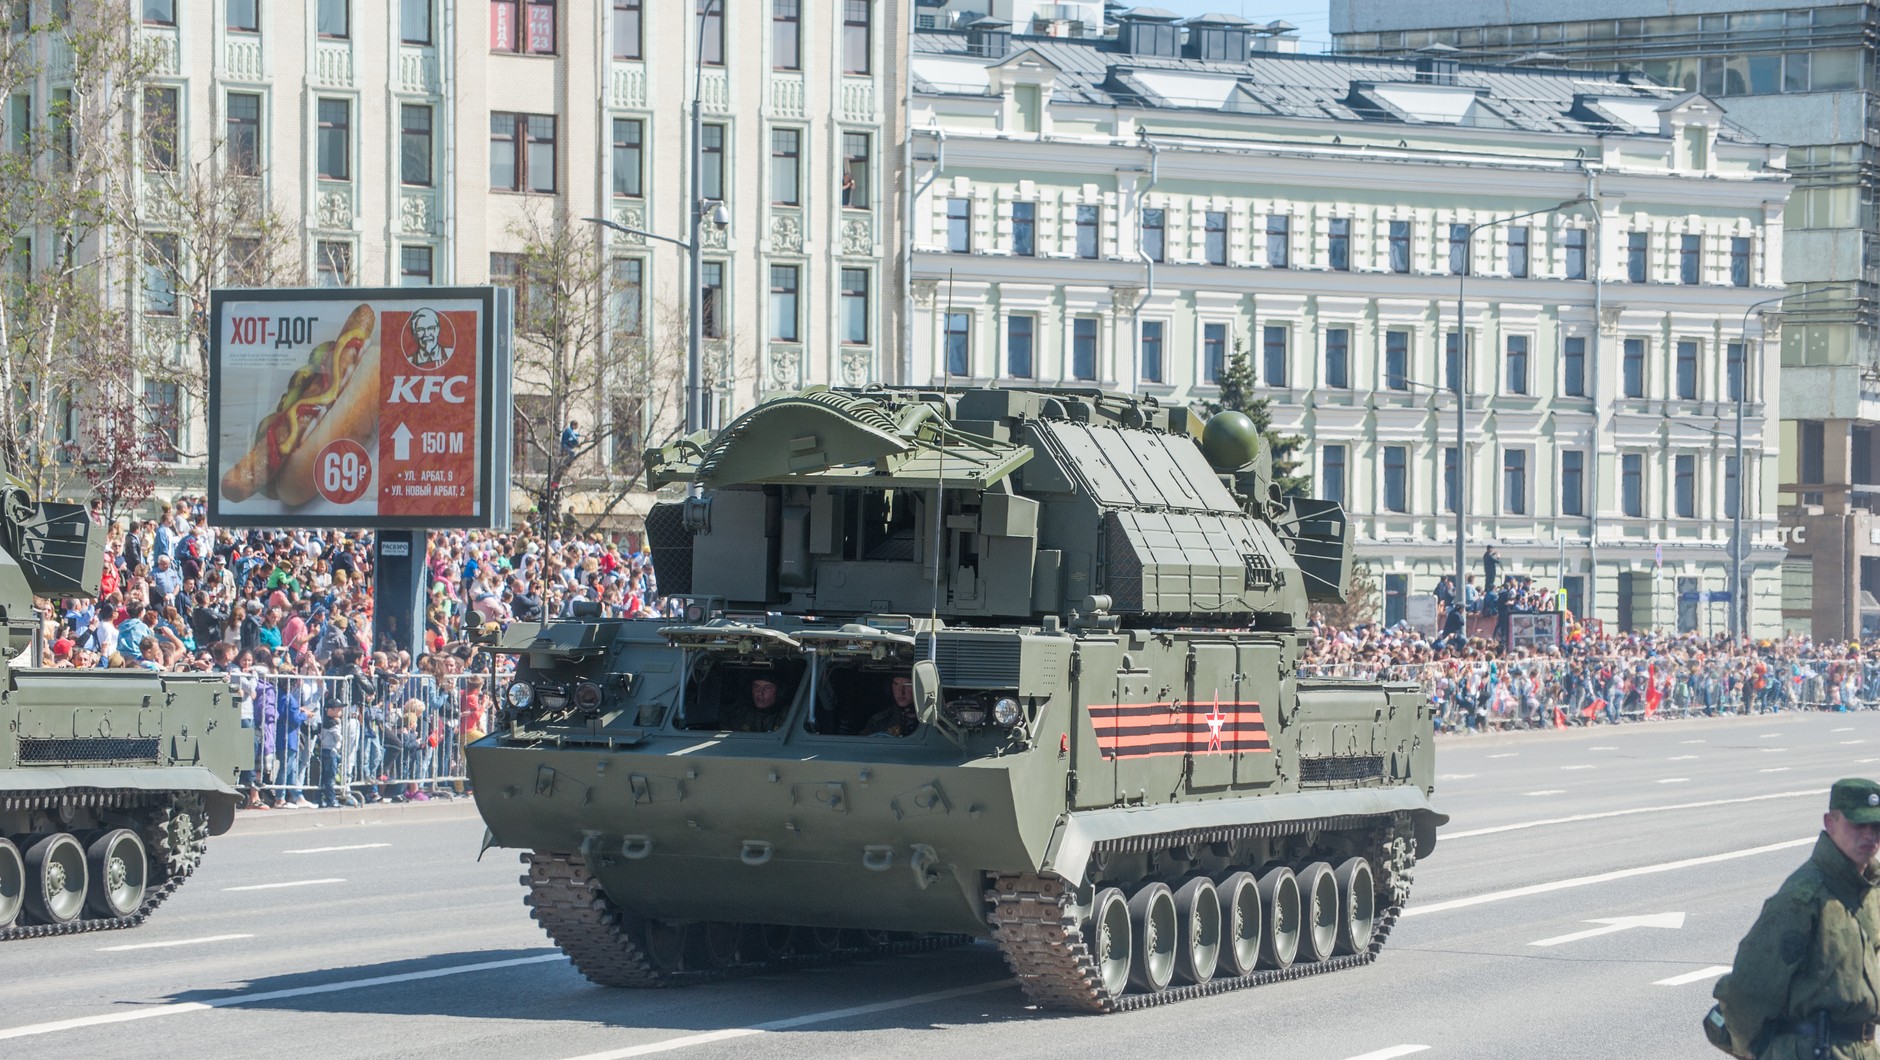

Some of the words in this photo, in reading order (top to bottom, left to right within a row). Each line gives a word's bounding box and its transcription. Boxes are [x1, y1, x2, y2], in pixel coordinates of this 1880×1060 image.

[532, 7, 549, 20] 72
[497, 3, 507, 48] АРЕНДА
[530, 22, 551, 34] 111
[532, 36, 549, 49] 23
[230, 316, 319, 349] ХОТ-ДОГ
[387, 375, 469, 403] KFC
[421, 432, 446, 454] 150
[449, 432, 464, 454] М
[404, 470, 416, 481] УЛ.
[421, 470, 446, 483] АРБАТ,
[391, 485, 403, 496] УЛ.
[405, 484, 432, 496] НОВЫЙ
[433, 485, 458, 497] АРБАТ,
[460, 485, 465, 496] 2
